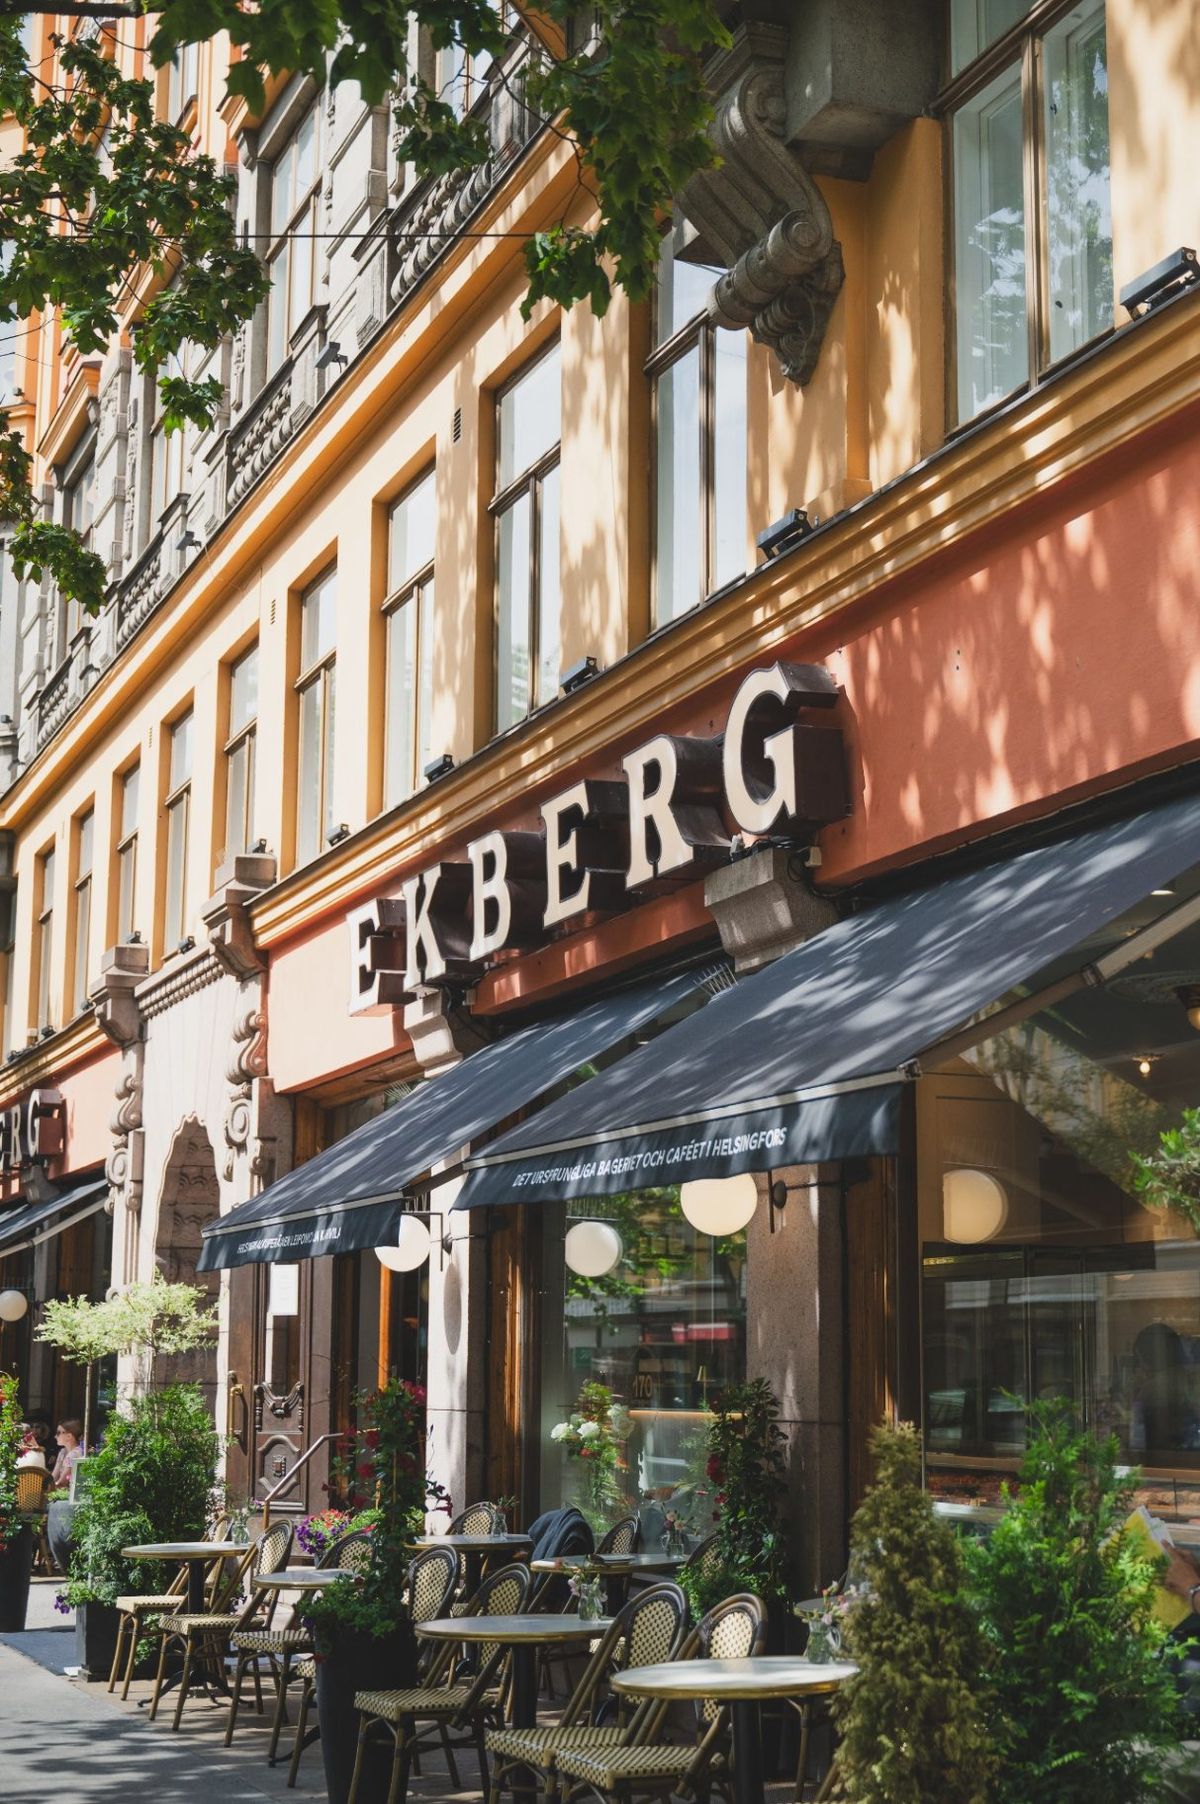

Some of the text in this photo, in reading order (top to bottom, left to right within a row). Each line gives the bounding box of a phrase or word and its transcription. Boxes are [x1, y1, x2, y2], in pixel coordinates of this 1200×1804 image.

[346, 661, 800, 1016] EKBERG
[512, 1172, 533, 1187] DET
[531, 1161, 596, 1185] URSPRUNGLIGA
[596, 1153, 643, 1177] BAGERIET
[642, 1149, 666, 1168] OCH
[666, 1139, 707, 1164] CAFÉET
[712, 1127, 787, 1156] HELSINGFORS
